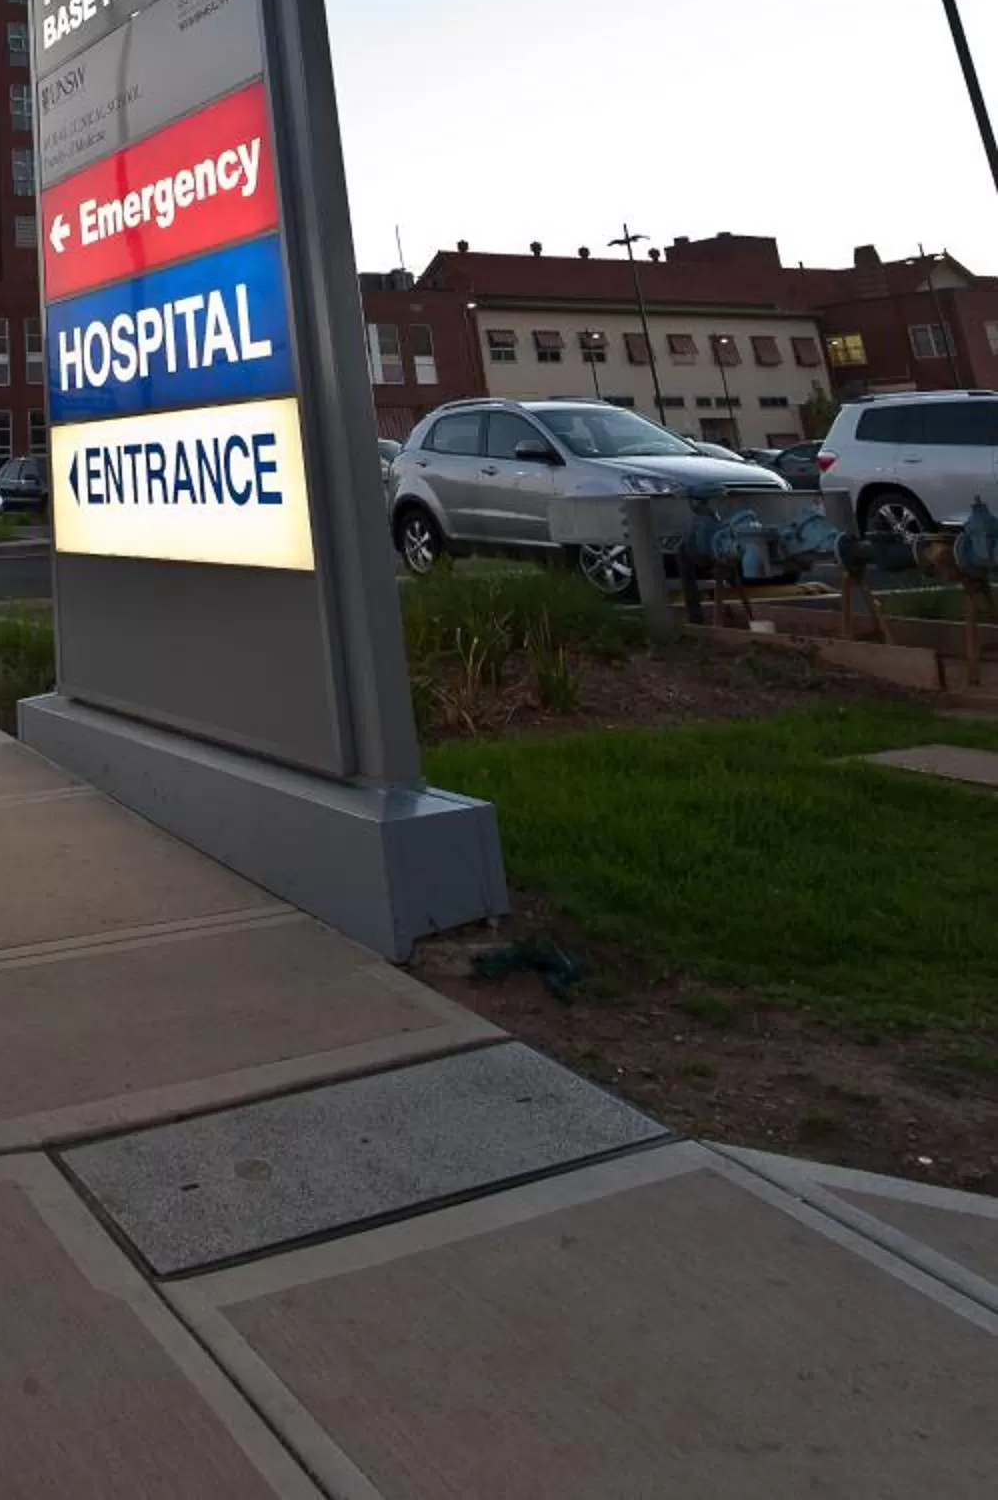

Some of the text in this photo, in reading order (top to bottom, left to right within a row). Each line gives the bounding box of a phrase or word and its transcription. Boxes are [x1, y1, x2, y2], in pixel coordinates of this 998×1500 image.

[79, 137, 261, 246] Emergency
[58, 283, 272, 391] HOSPITAL
[85, 432, 283, 506] ENTRANCE
